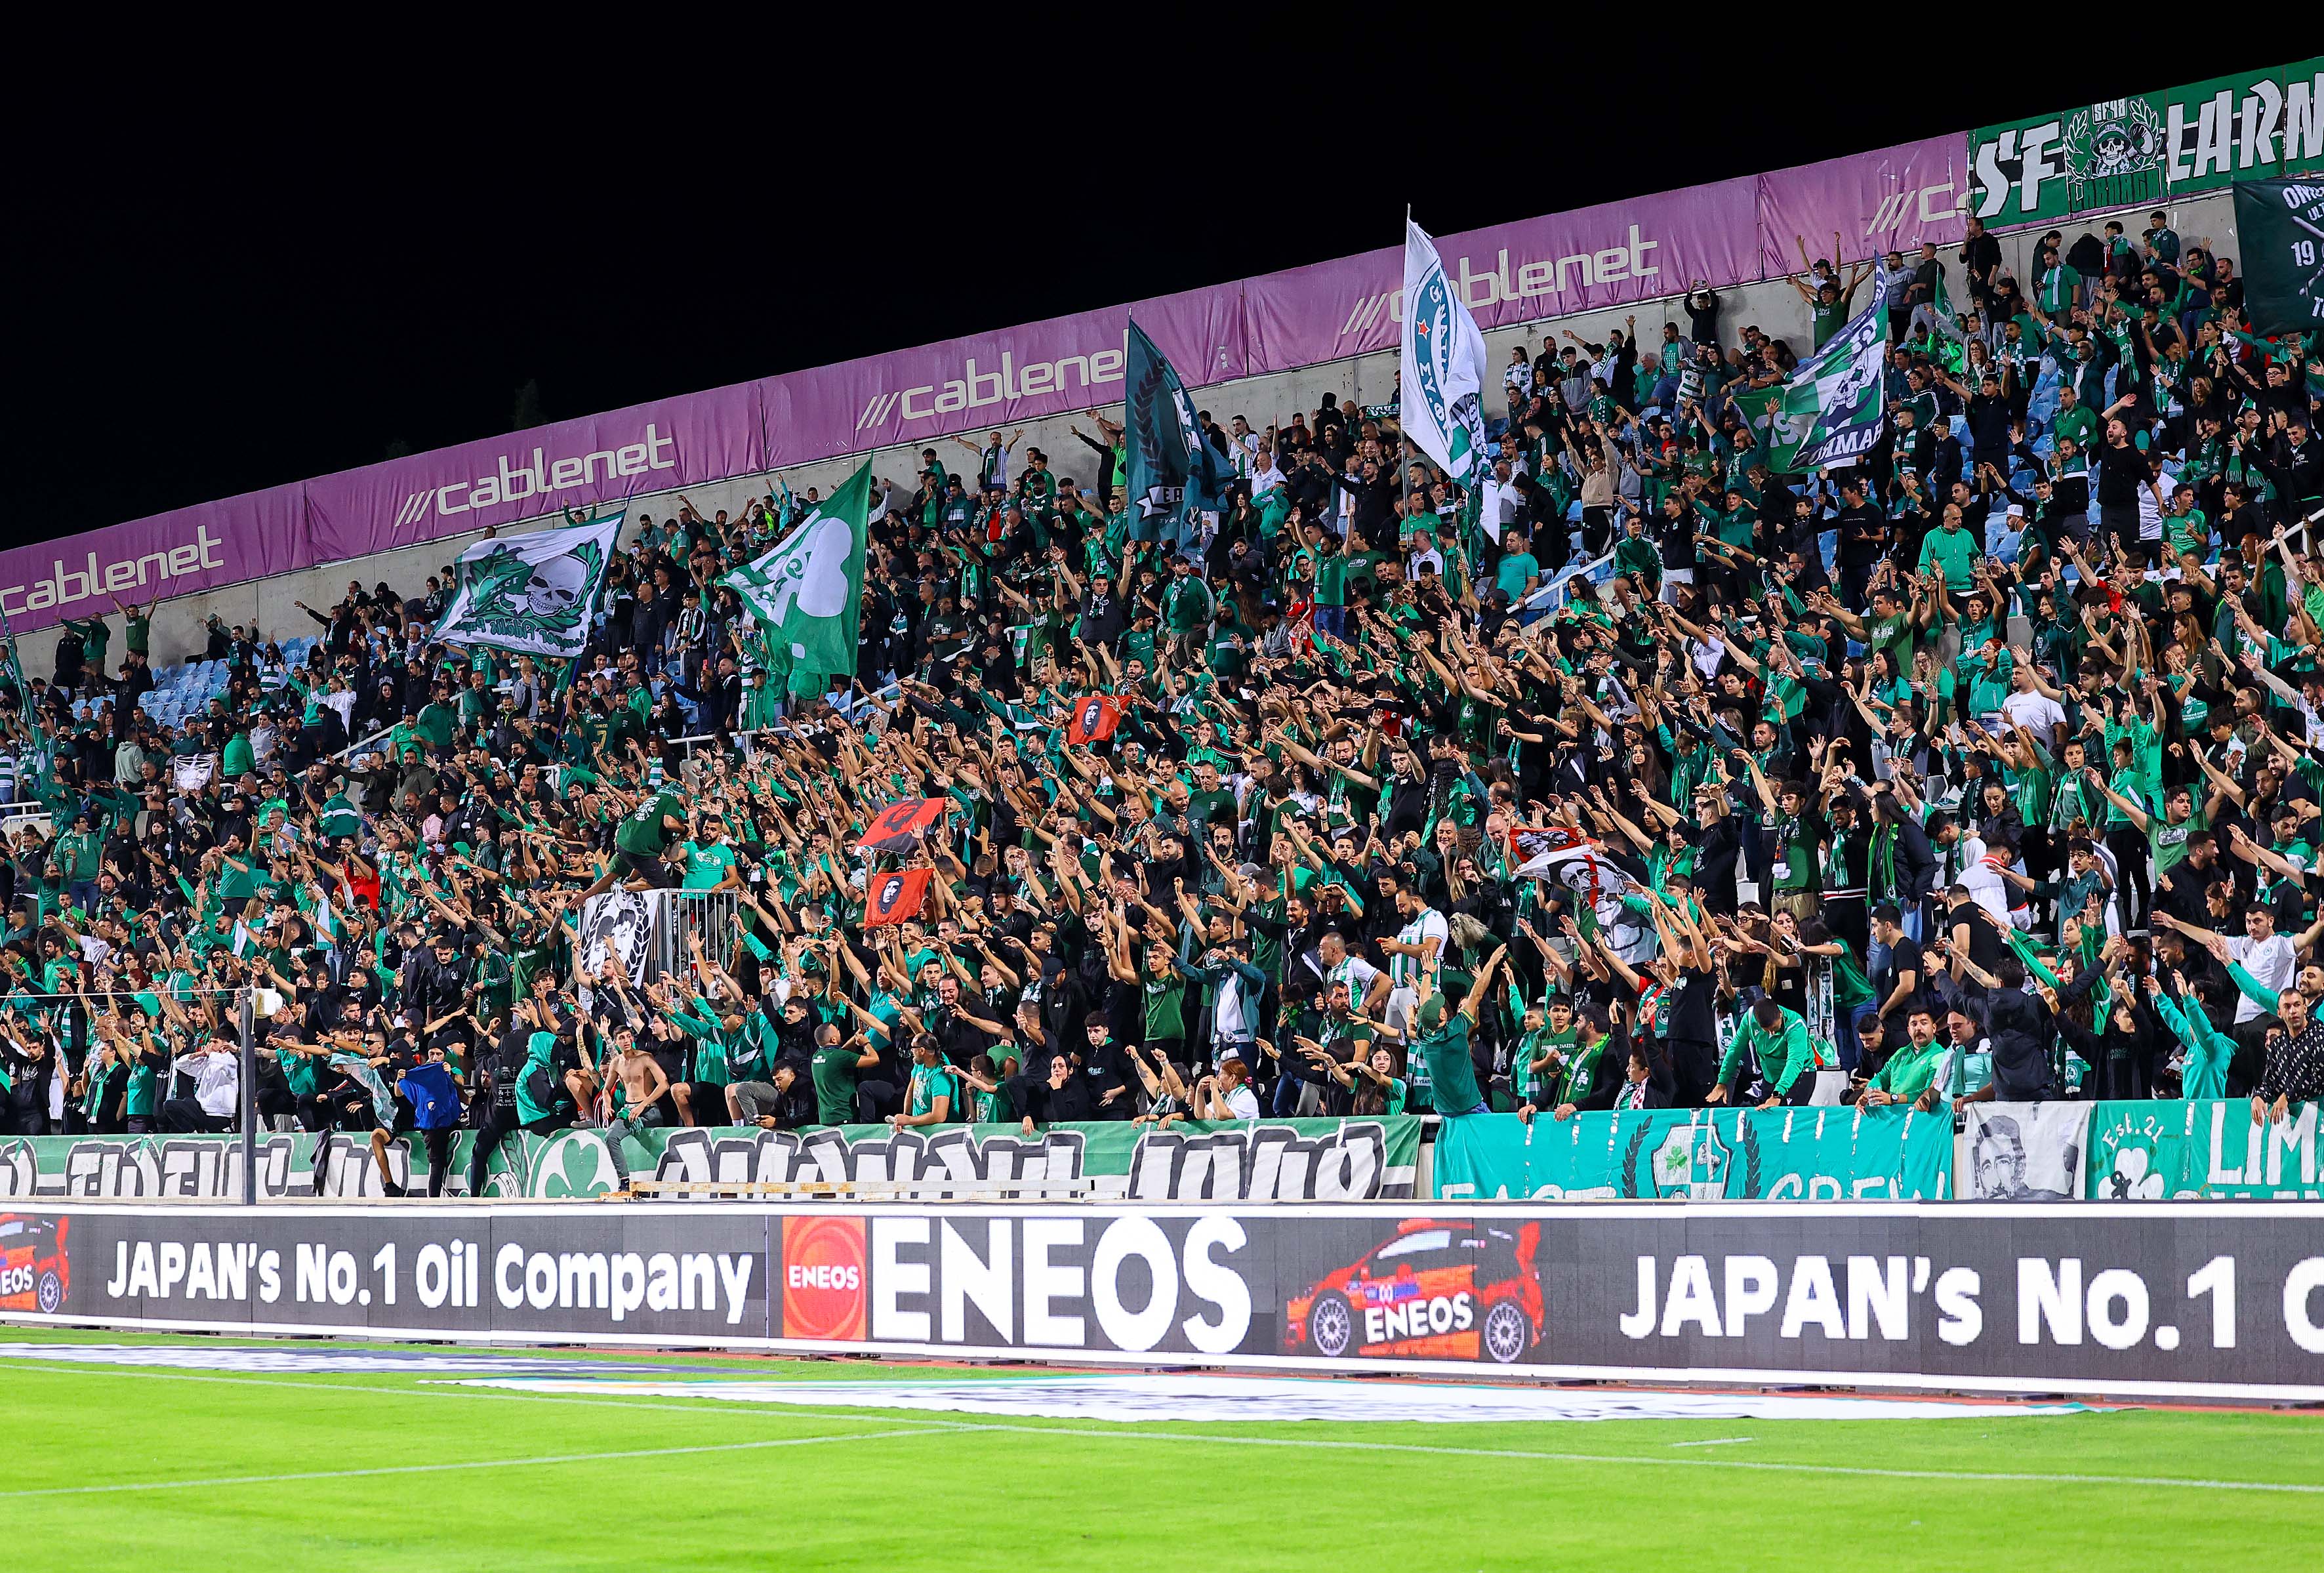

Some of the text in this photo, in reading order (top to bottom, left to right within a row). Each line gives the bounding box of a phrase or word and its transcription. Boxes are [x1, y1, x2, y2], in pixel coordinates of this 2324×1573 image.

[2093, 98, 2127, 123] SF48
[1975, 121, 2060, 218] SF
[901, 328, 1129, 420] cablene
[438, 423, 675, 516] cablenet
[0, 525, 224, 617] cablenet
[596, 729, 607, 750] 7
[2102, 1113, 2164, 1150] Est. 21
[2207, 1101, 2324, 1186] LIM
[0, 1263, 34, 1294] EOS
[107, 1238, 754, 1324] JAPAN's No.1 Oil Company
[788, 1265, 860, 1290] ENEOS
[872, 1215, 1252, 1354] ENEOS
[1364, 1291, 1474, 1343] ENEOS
[1619, 1254, 1984, 1347] JAPAN's
[2017, 1254, 2236, 1351] No.1
